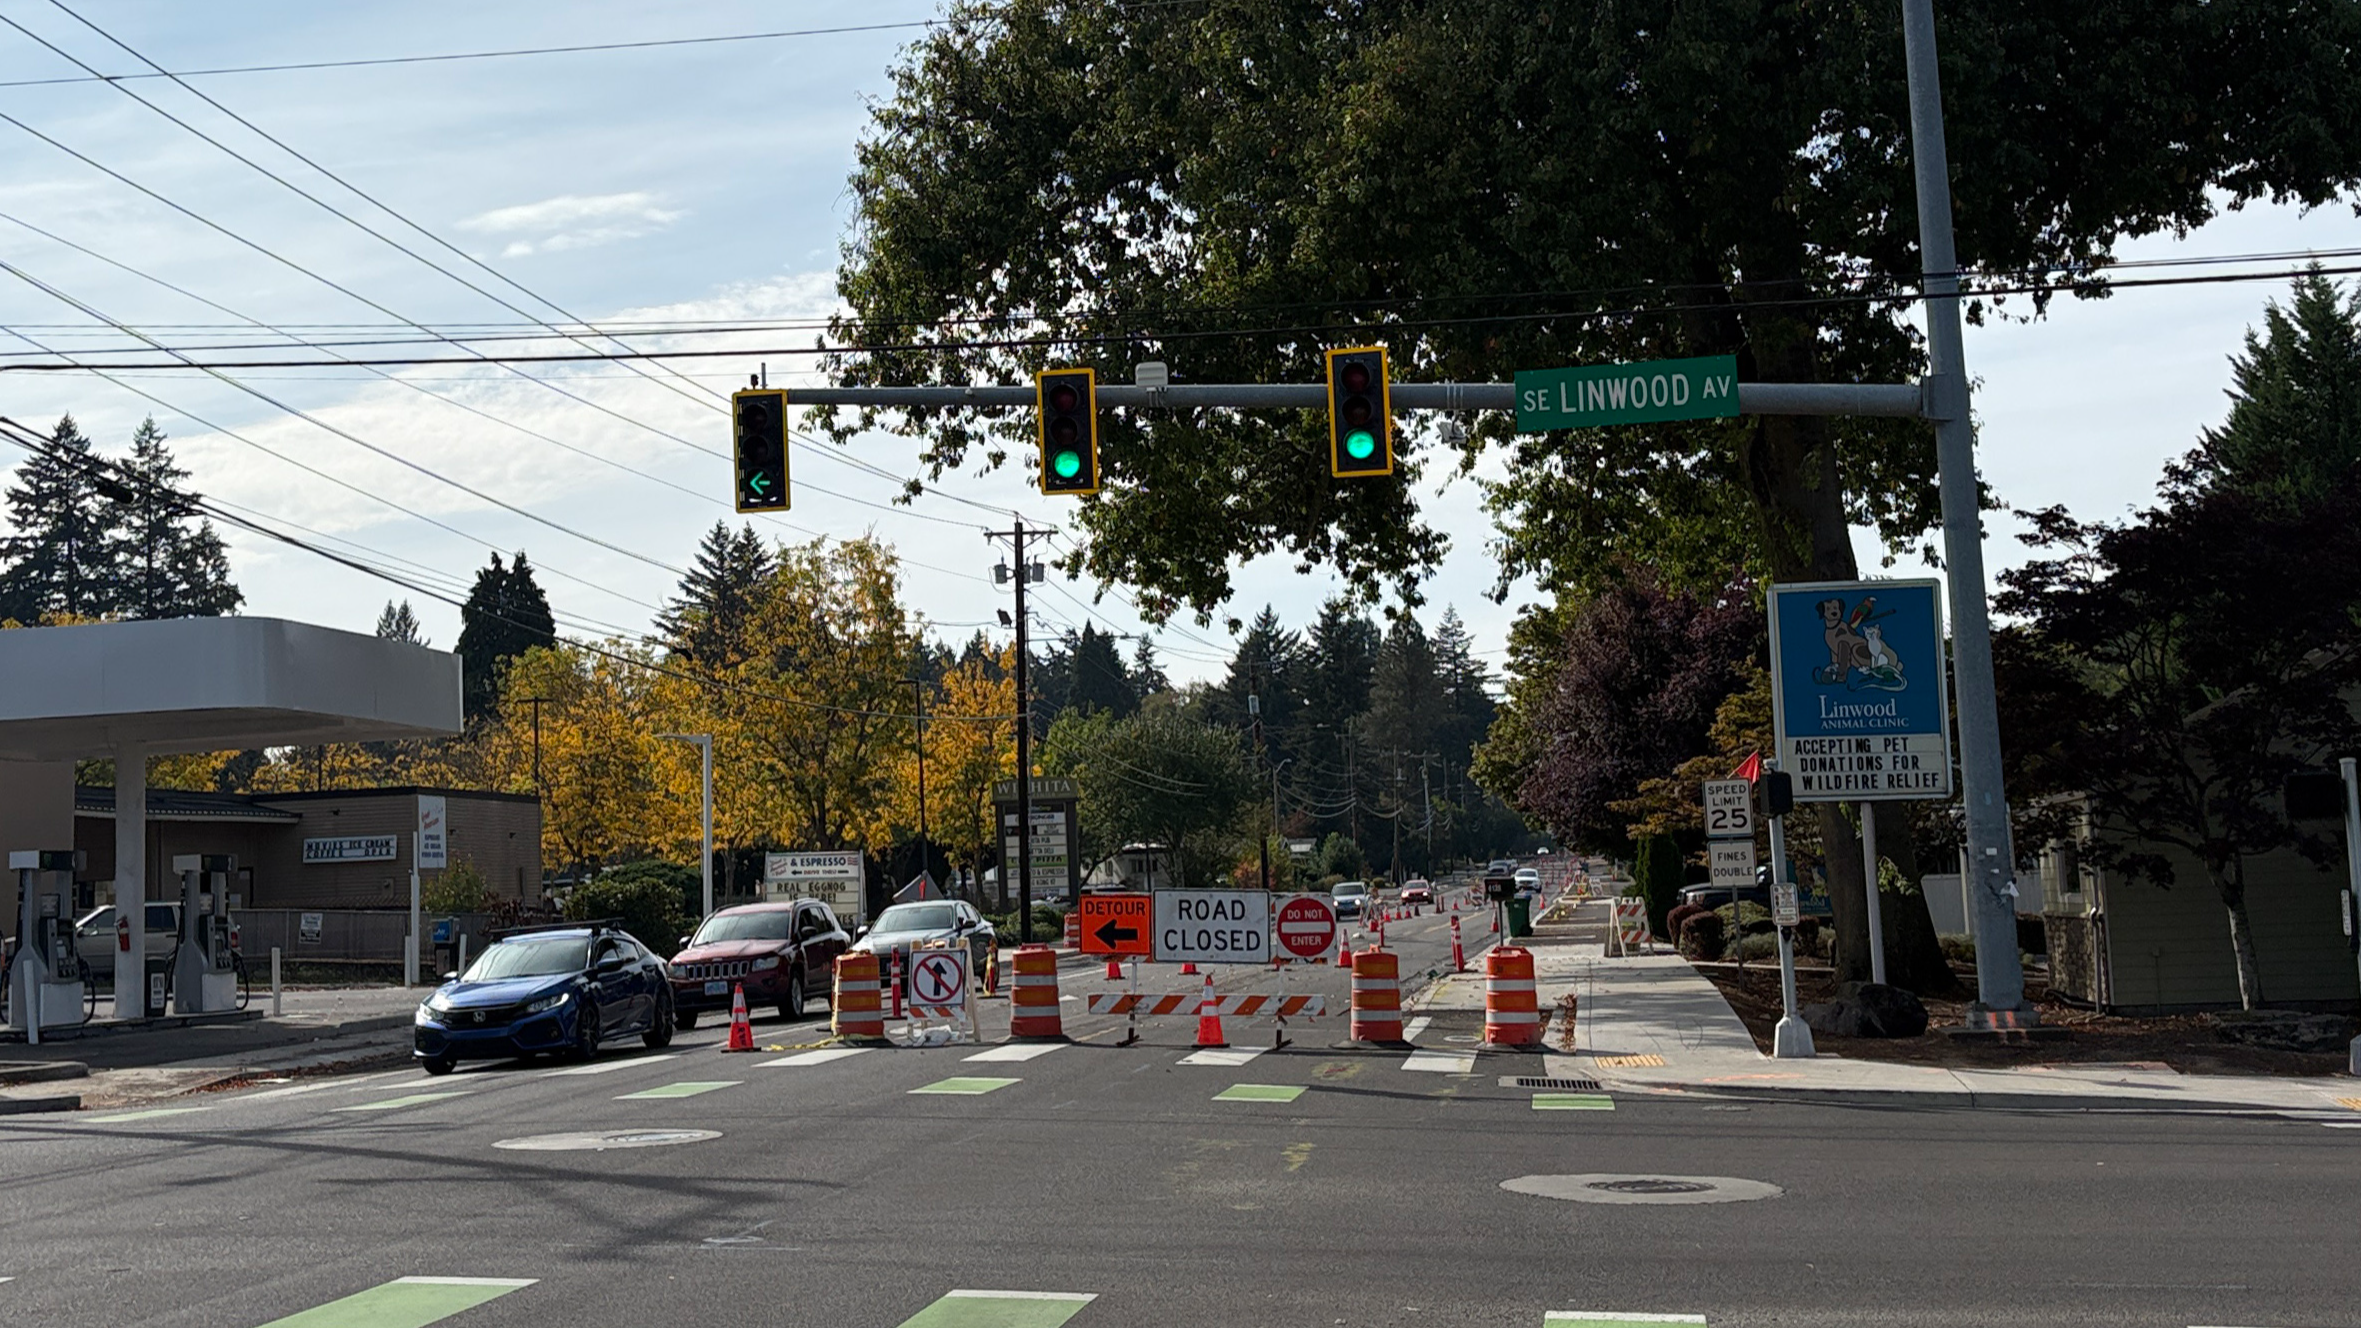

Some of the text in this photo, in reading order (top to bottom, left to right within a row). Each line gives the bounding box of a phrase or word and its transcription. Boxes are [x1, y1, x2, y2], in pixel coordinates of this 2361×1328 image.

[1523, 373, 1731, 414] SE LINWOOD AV
[1819, 695, 1897, 719] Linwood
[1821, 717, 1910, 730] ANIMAL CLINIC
[1795, 737, 1909, 755] ACCEPTING PET
[1801, 754, 1920, 773] DONATIONS FOR
[997, 780, 1071, 795] WIHITA
[1802, 772, 1939, 791] WILDFIRE RELIEF
[1708, 785, 1747, 795] SPEED
[1712, 796, 1743, 807] LIMIT
[1711, 808, 1748, 830] 25
[306, 839, 391, 850] MOVIES ICE CREAM
[790, 858, 798, 867] &
[800, 857, 846, 867] ESPRESSO
[1717, 851, 1747, 862] FINES
[1713, 867, 1753, 877] DOUBLE
[777, 881, 846, 892] REAL EGGNOG
[1085, 901, 1145, 916] DETOUR
[1178, 899, 1246, 921] ROAD
[1287, 908, 1323, 920] DO NOT
[1164, 929, 1261, 951] CLOSED
[1291, 935, 1322, 947] ENTER
